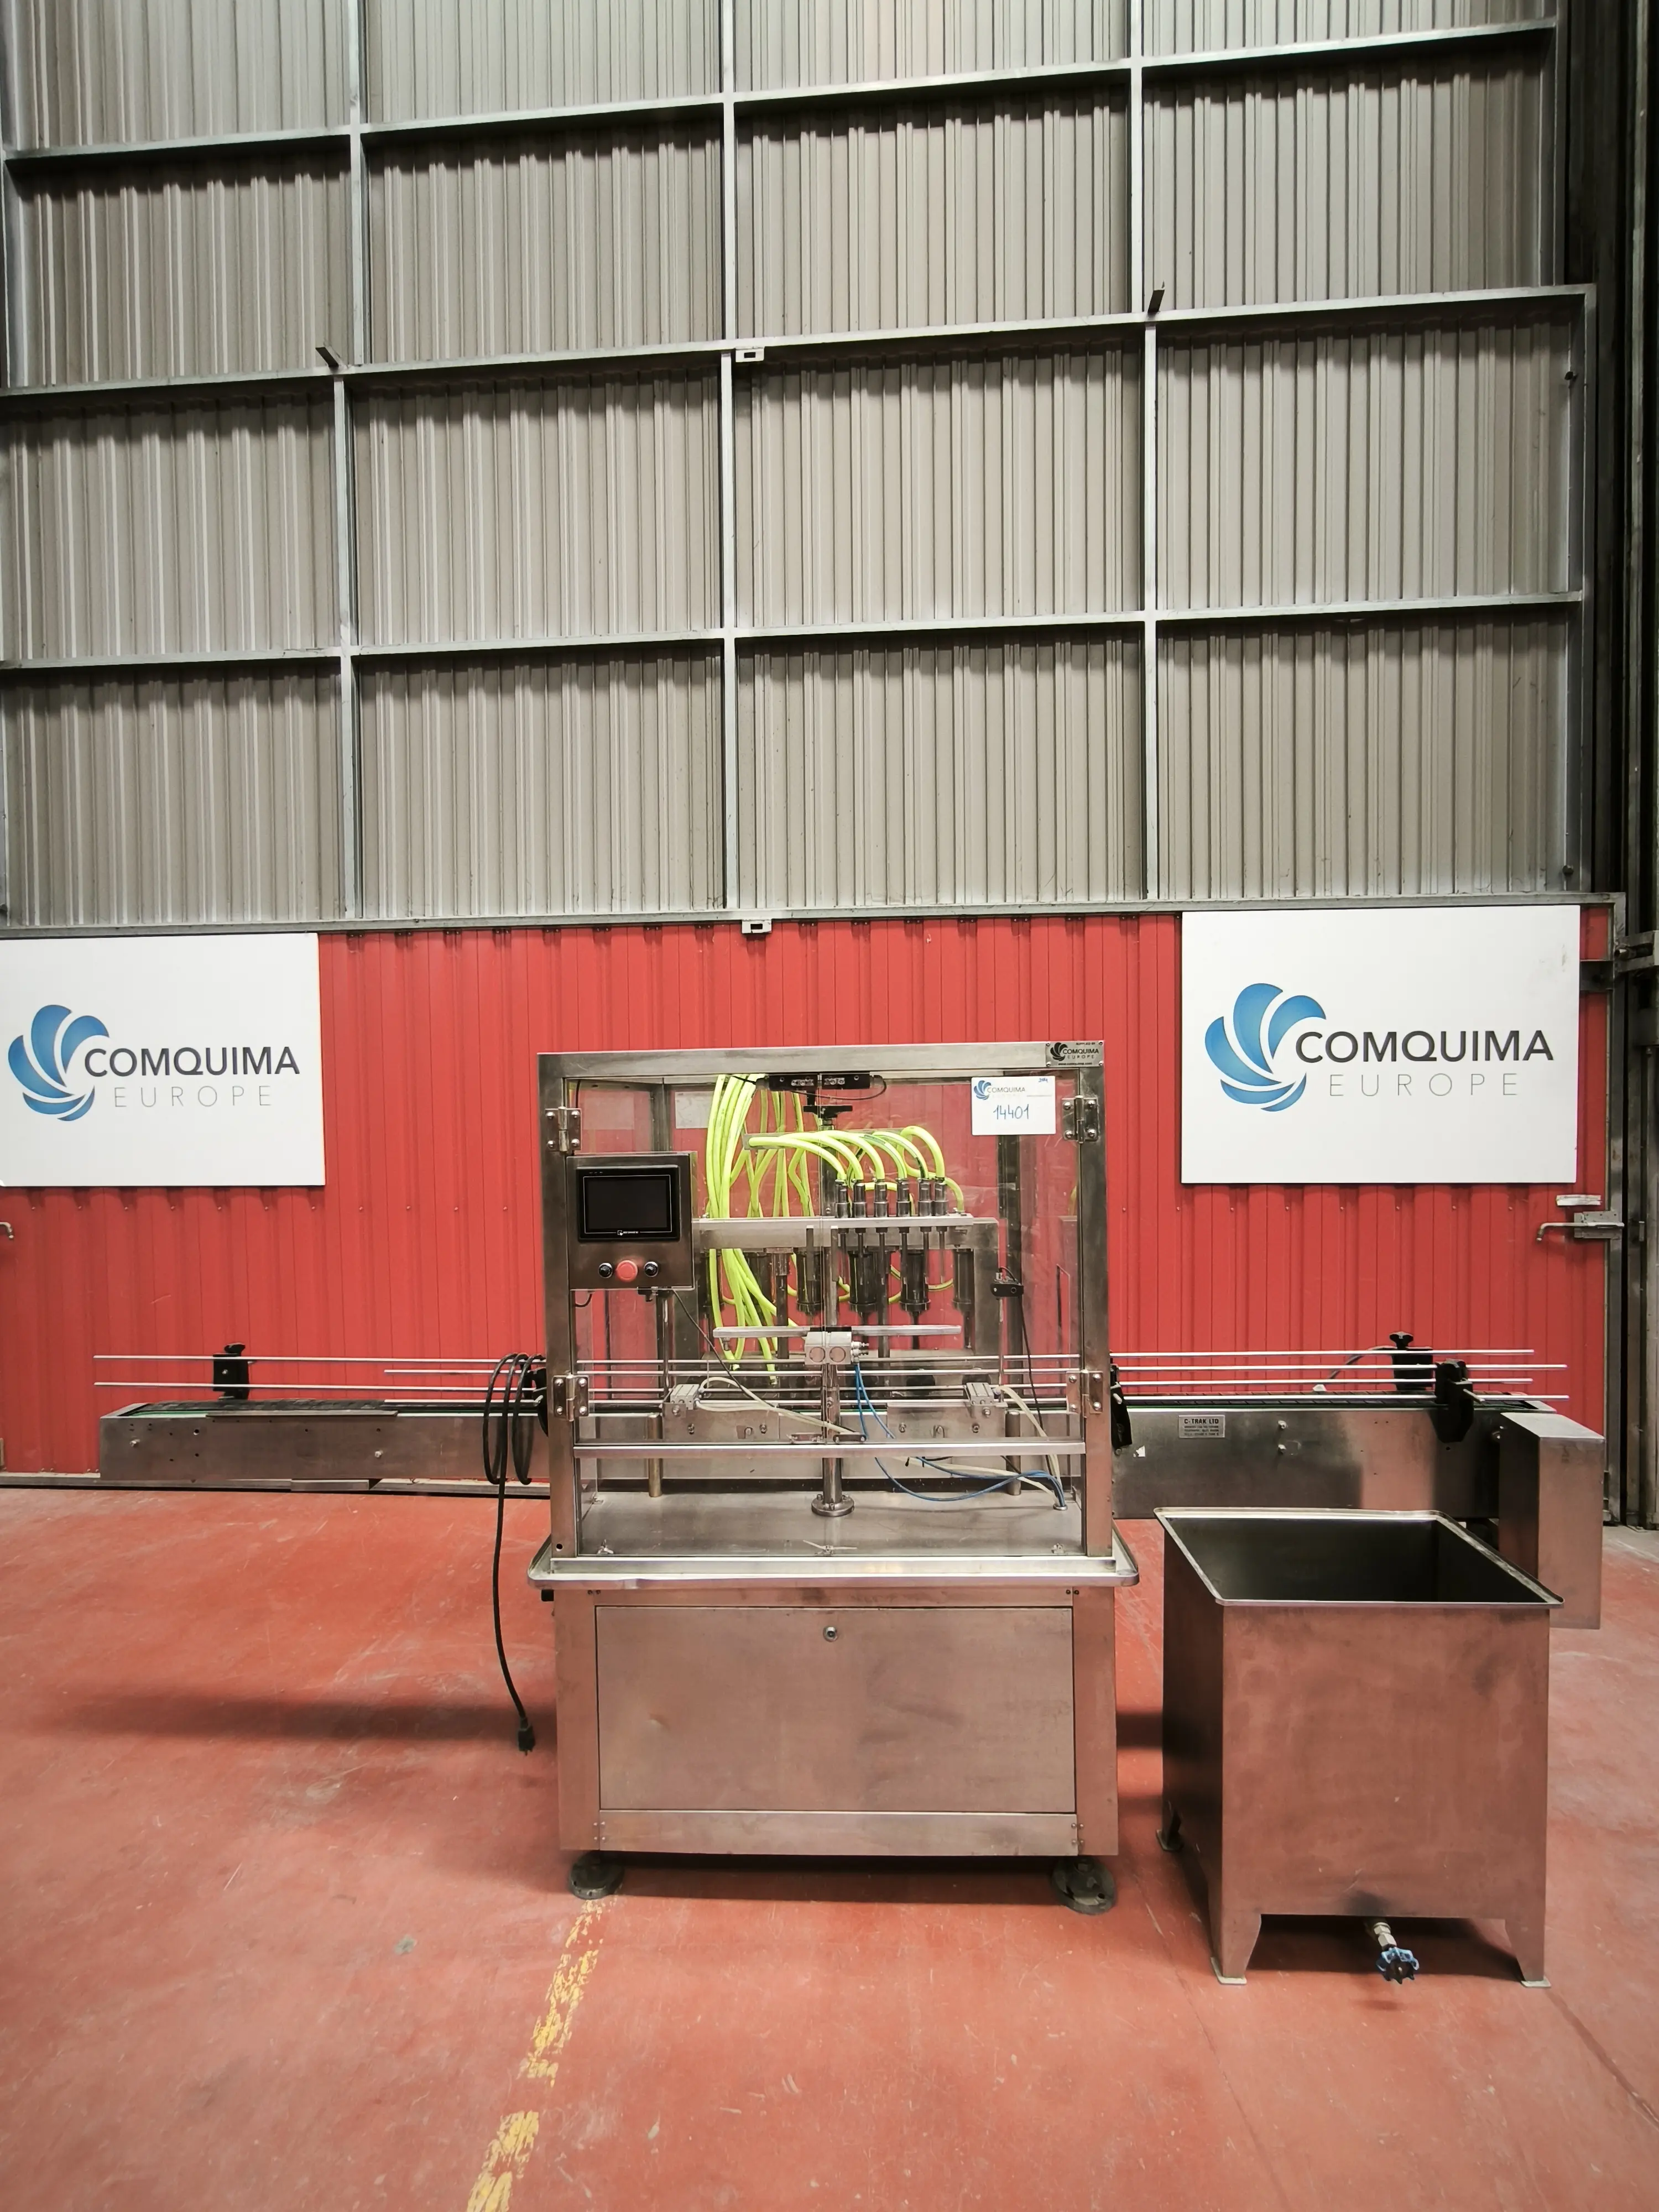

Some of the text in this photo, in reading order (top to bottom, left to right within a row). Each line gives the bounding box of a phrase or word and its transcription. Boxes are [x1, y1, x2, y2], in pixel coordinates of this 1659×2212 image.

[1296, 1030, 1554, 1063] COMQUIMA
[85, 1046, 300, 1077] COMQUIMA
[114, 1086, 272, 1107] EUROPE
[1330, 1073, 1517, 1097] EUROPE
[993, 1104, 1029, 1120] 14401
